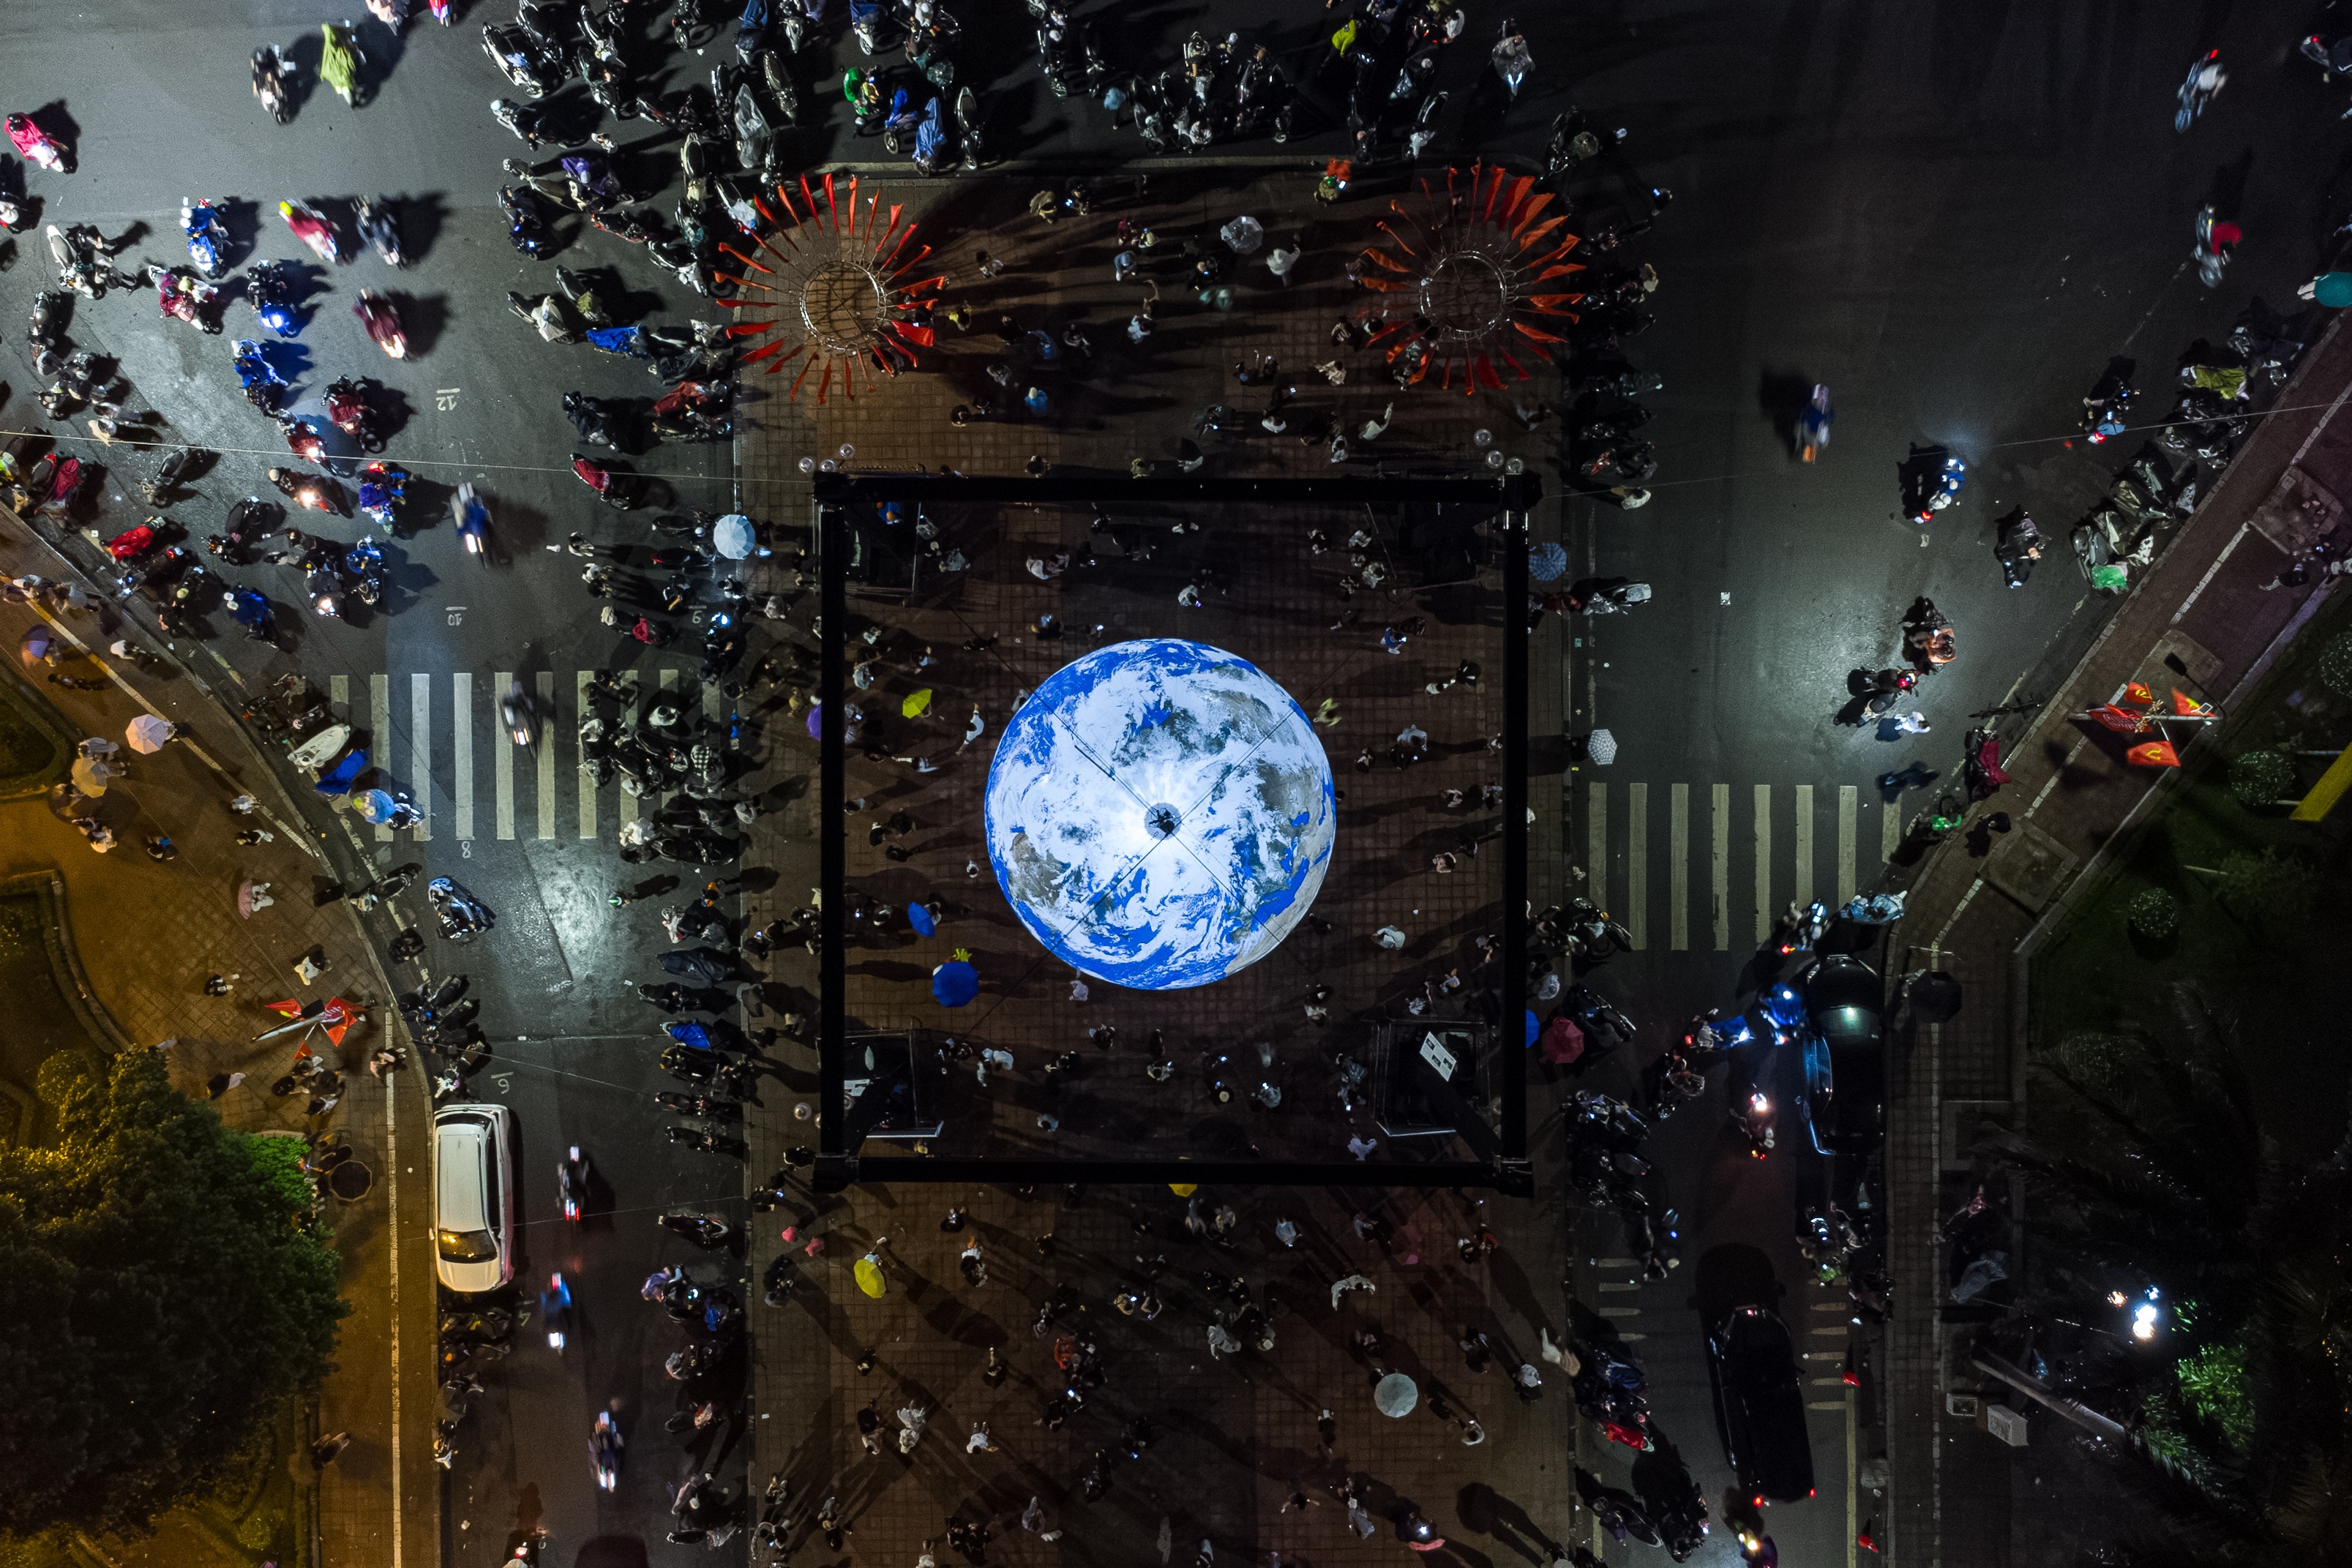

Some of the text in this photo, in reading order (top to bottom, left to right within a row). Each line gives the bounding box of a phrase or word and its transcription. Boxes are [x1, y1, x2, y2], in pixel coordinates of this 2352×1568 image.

[436, 395, 457, 411] 12
[447, 613, 462, 626] 10
[461, 841, 471, 859] 8
